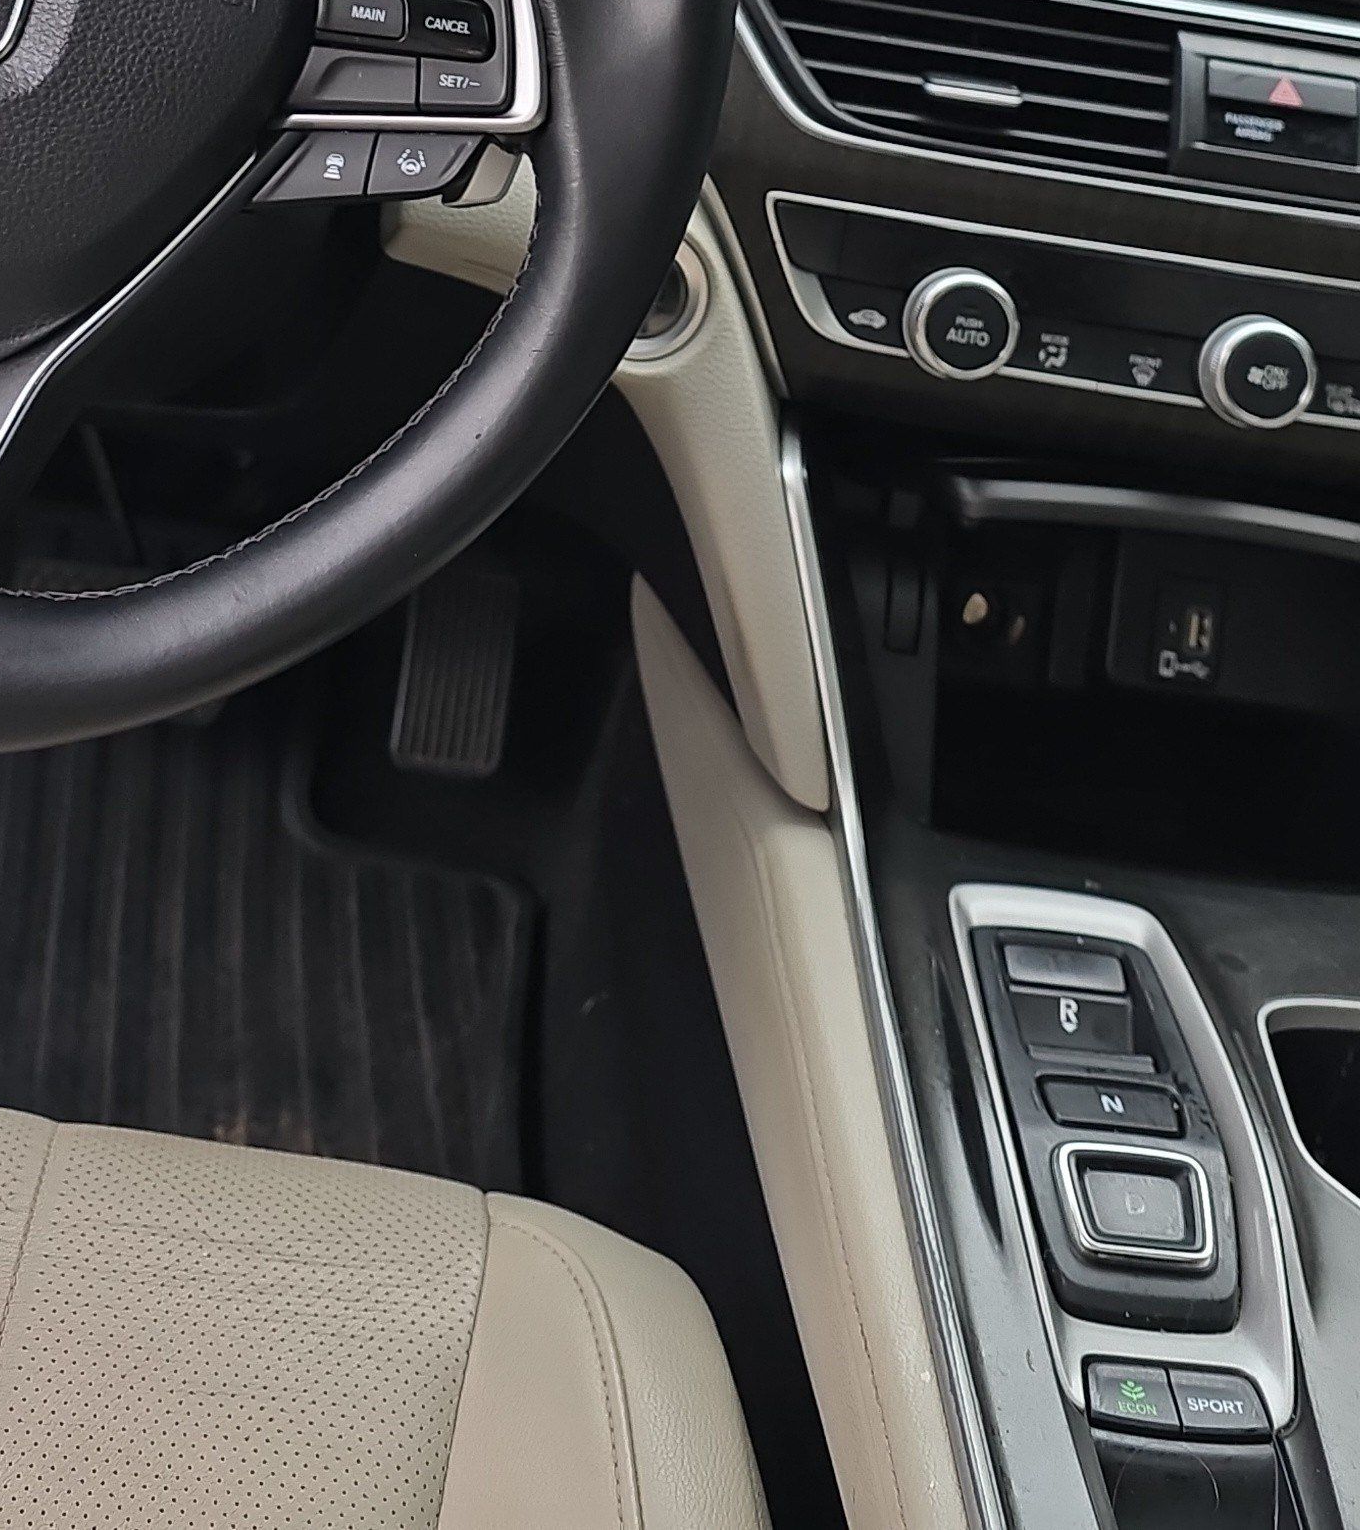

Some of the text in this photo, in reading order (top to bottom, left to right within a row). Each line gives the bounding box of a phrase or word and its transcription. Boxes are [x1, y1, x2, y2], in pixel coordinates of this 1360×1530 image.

[350, 5, 386, 23] MAIN
[424, 16, 471, 35] CANCEL
[945, 327, 990, 348] AUTO
[1059, 996, 1080, 1029] R
[1100, 1092, 1126, 1115] N
[1117, 1399, 1159, 1418] ECON
[1186, 1396, 1244, 1416] SPORT
